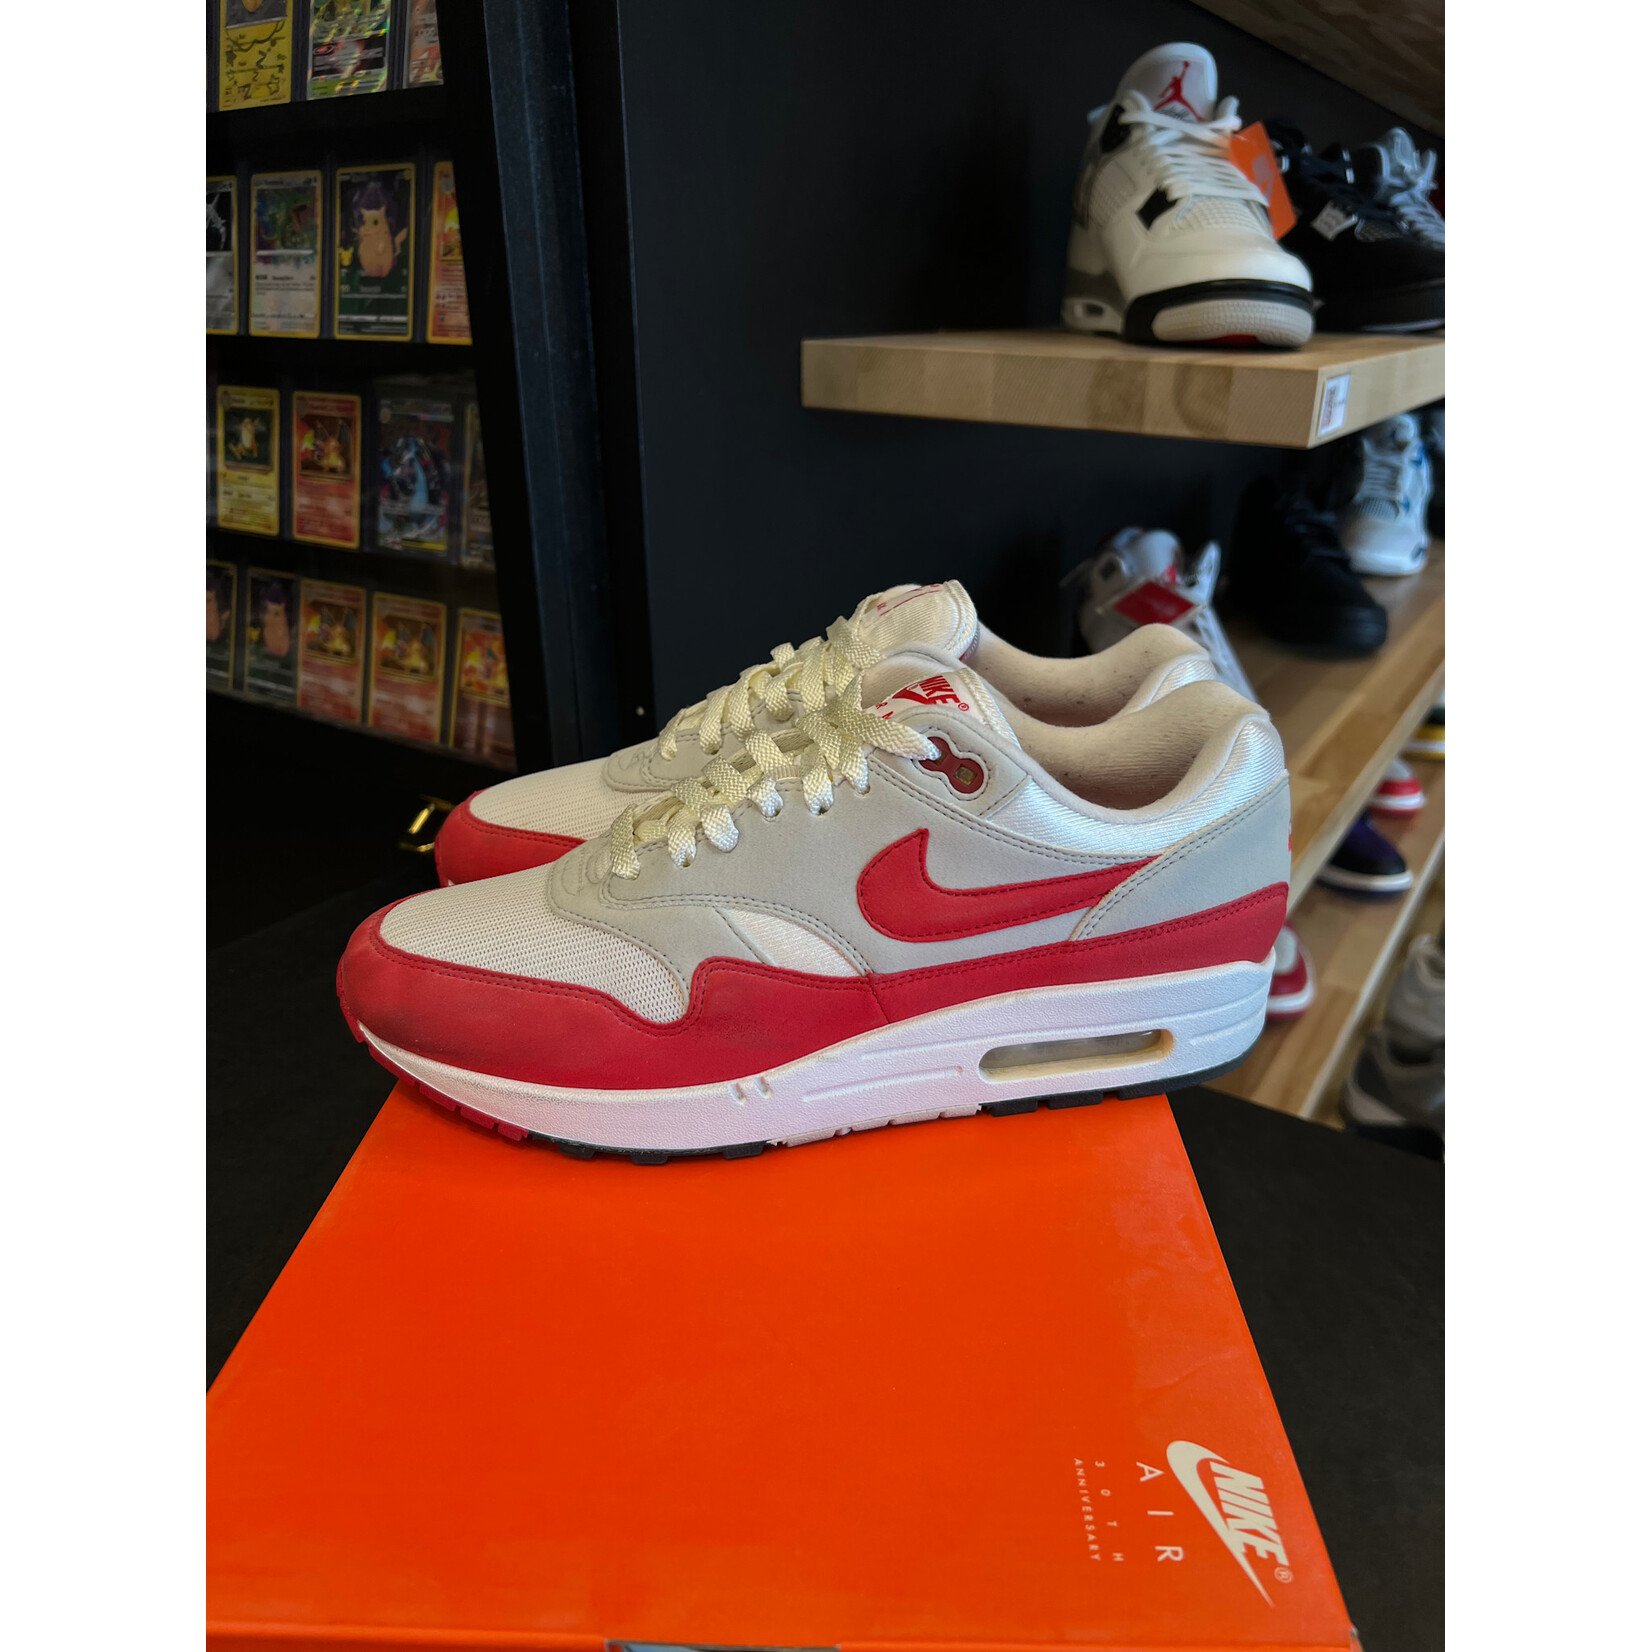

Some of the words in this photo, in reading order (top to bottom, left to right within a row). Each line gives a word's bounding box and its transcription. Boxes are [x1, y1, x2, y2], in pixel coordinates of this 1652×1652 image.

[1073, 1457, 1101, 1561] ANNIVERSARY
[1136, 1461, 1184, 1562] AIR
[1209, 1461, 1290, 1567] NIKE
